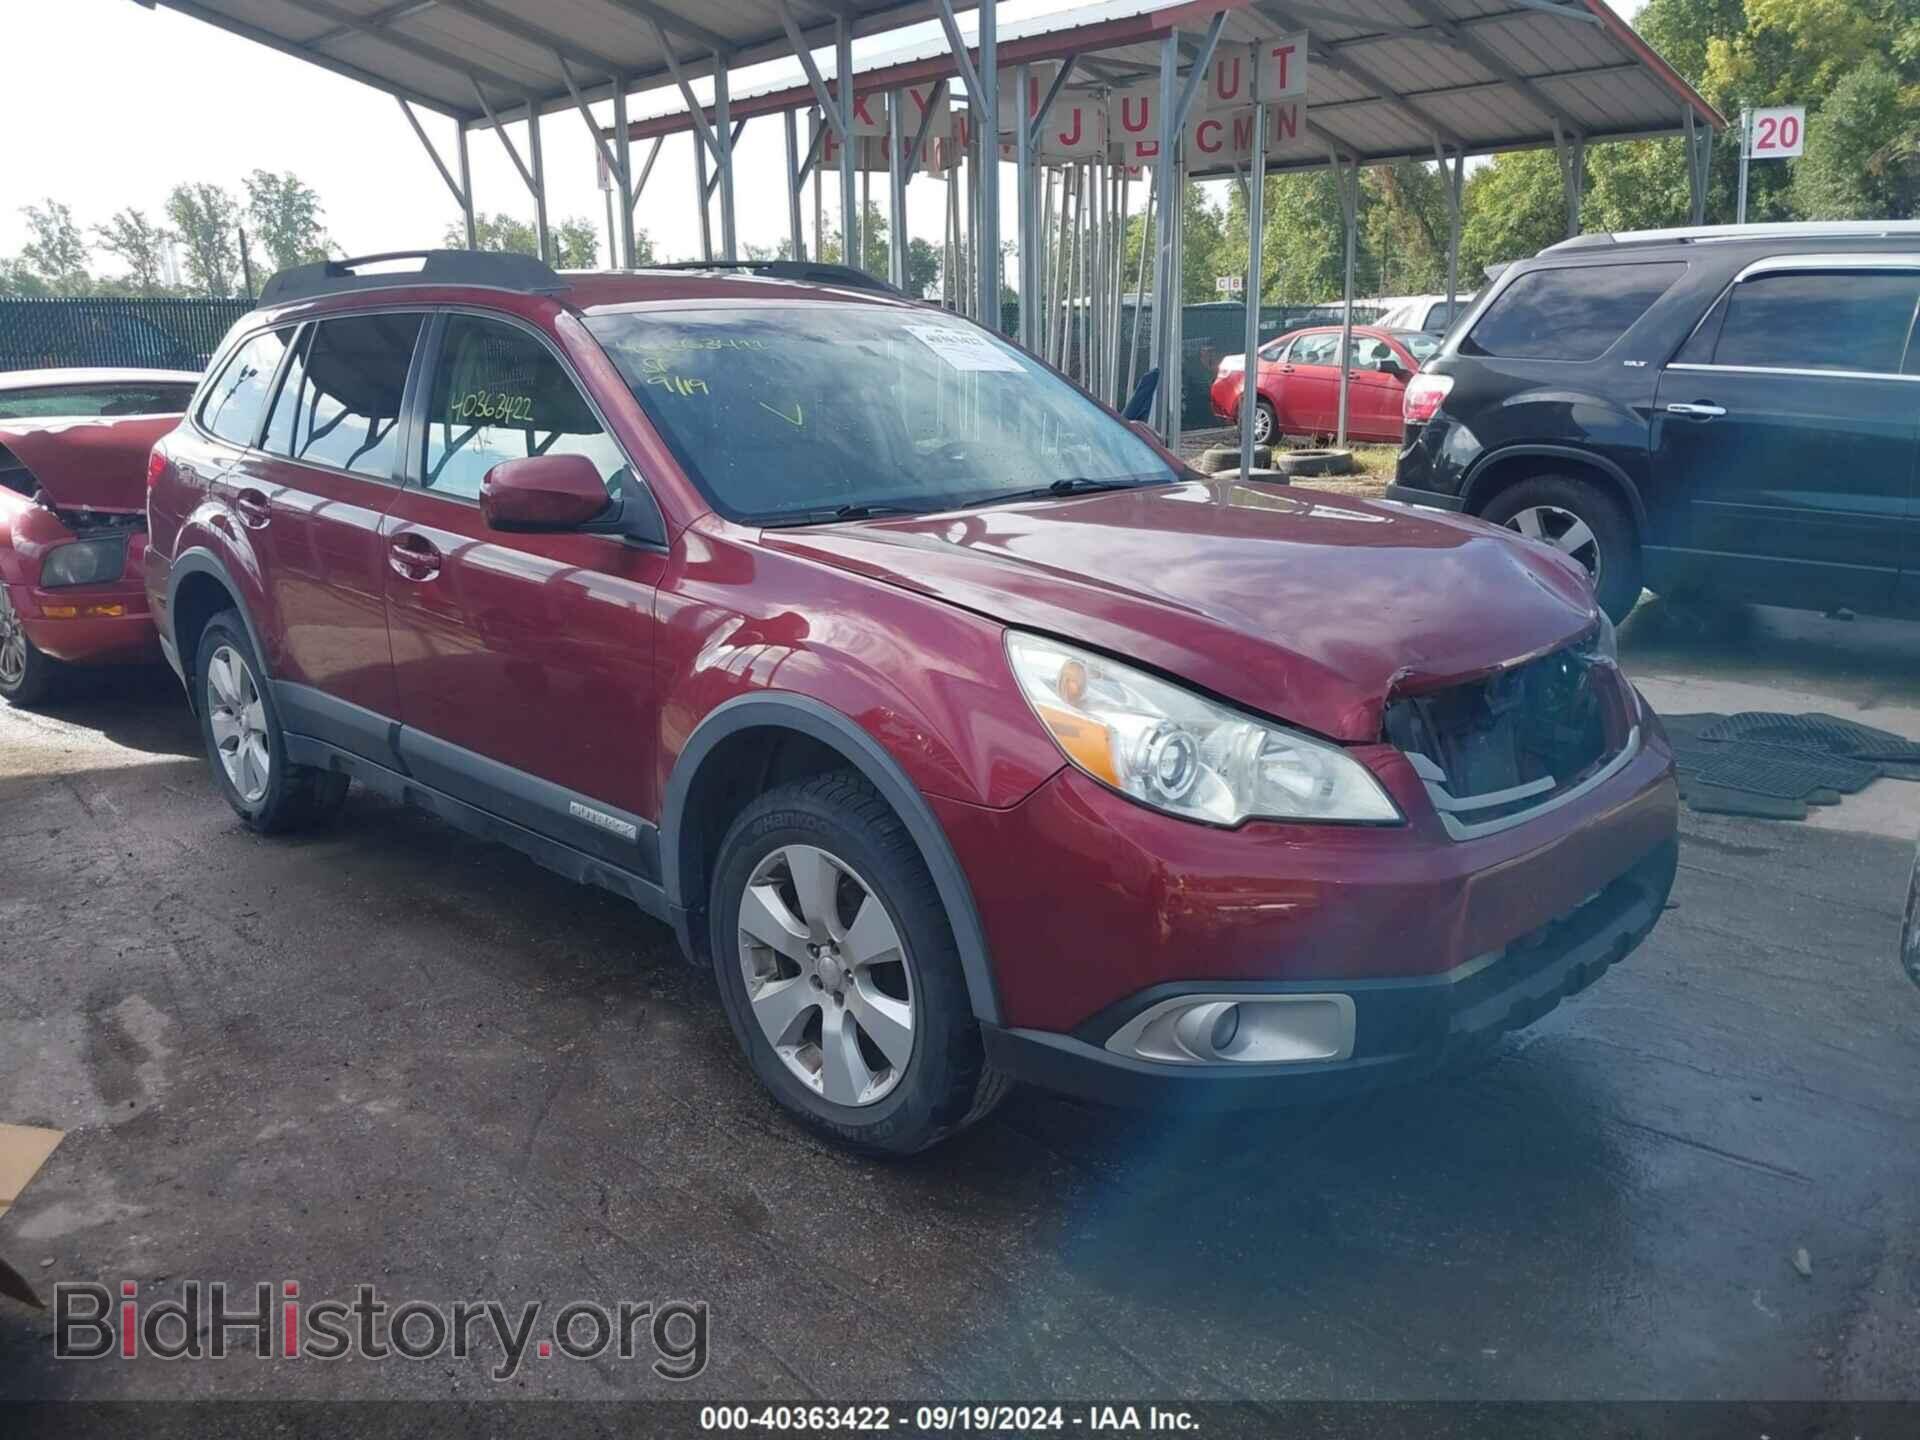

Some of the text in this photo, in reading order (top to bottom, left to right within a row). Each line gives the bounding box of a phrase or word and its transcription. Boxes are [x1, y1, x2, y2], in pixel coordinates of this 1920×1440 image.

[1216, 57, 1240, 99] U
[1272, 46, 1296, 89] T
[1059, 108, 1081, 146] J
[1122, 97, 1148, 132] U
[1277, 103, 1297, 142] N
[1196, 120, 1223, 153] C
[1757, 116, 1799, 150] 20
[451, 390, 534, 424] 40363422
